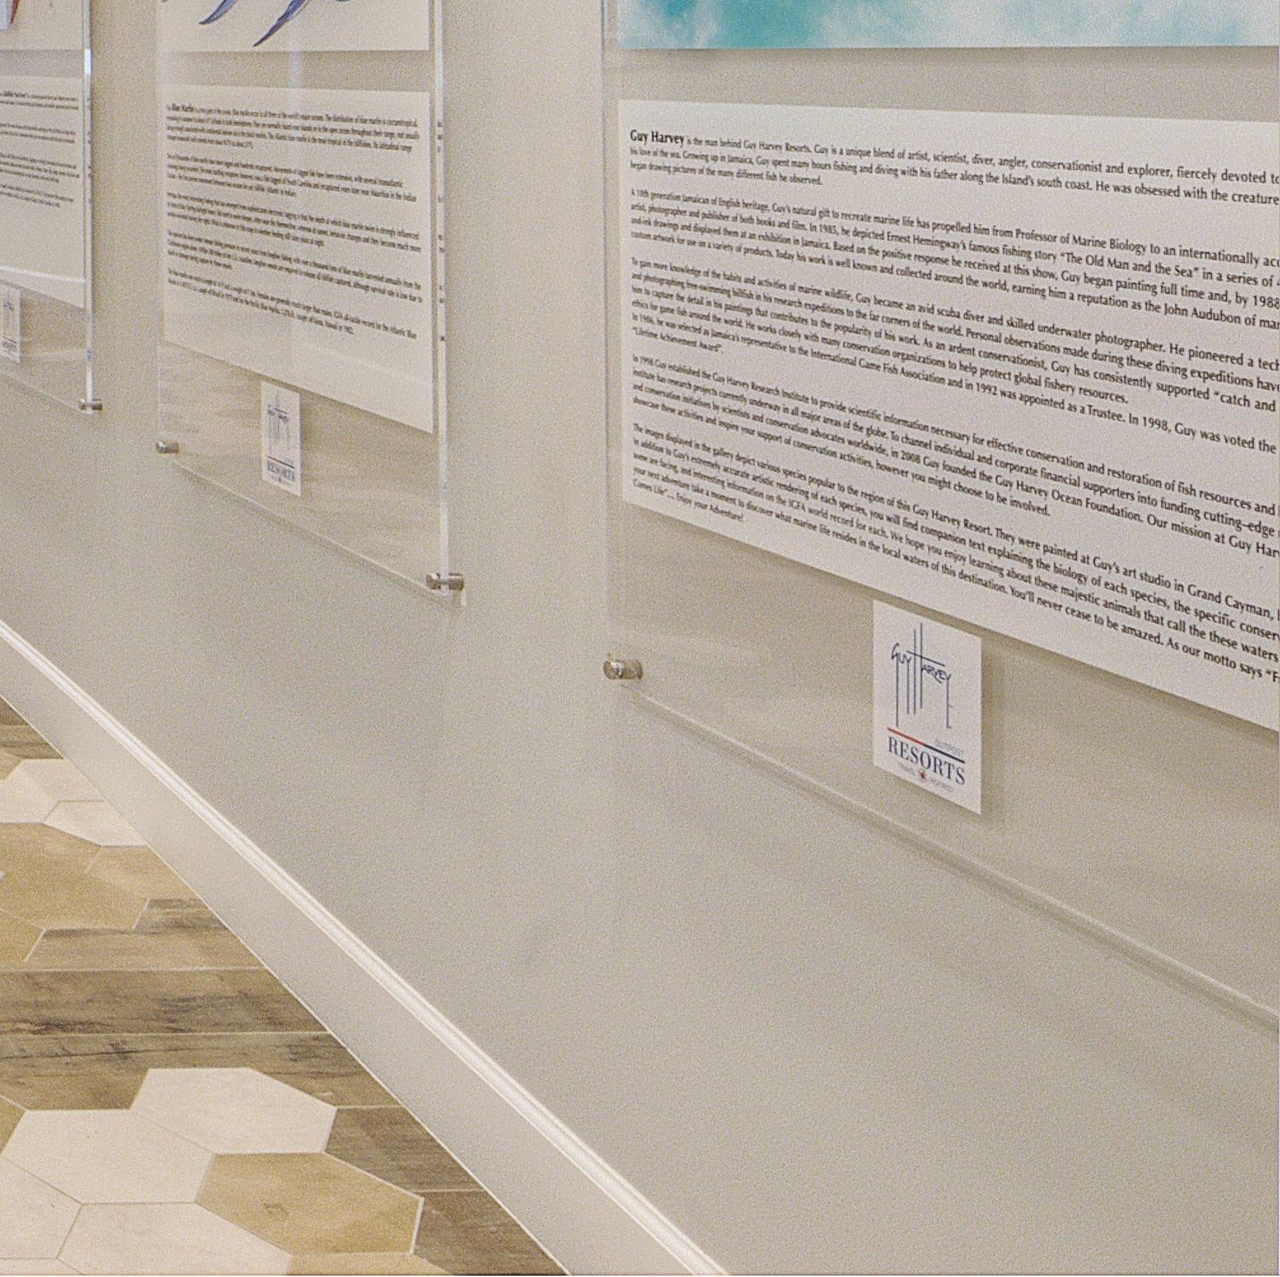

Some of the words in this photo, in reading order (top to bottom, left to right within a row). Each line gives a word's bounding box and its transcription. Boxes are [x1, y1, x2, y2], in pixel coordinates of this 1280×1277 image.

[629, 129, 648, 146] Guy
[651, 130, 684, 148] Harvey
[845, 146, 871, 159] unique
[873, 146, 895, 159] blend
[897, 148, 905, 159] of
[907, 150, 930, 162] artist,
[933, 151, 969, 165] scientist,
[971, 153, 995, 167] diver,
[998, 155, 1028, 170] angler,
[1031, 159, 1102, 173] conservationist
[1105, 162, 1124, 174] and
[1127, 163, 1173, 179] explorer,
[1176, 165, 1217, 183] fiercely
[1220, 168, 1266, 184] devoted
[1036, 176, 1062, 188] south
[1064, 180, 1092, 191] coast.
[1096, 180, 1110, 192] He
[1112, 184, 1132, 194] was
[1134, 182, 1180, 197] obsessed
[1183, 186, 1207, 199] with
[1210, 188, 1228, 201] the
[1034, 250, 1057, 264] story
[1085, 254, 1104, 267] Old
[1107, 257, 1129, 270] Man
[1132, 260, 1151, 273] and
[1154, 262, 1171, 275] the
[1202, 267, 1213, 280] in
[1216, 272, 1222, 282] a
[1226, 271, 1258, 285] series
[1261, 274, 1274, 287] of
[1060, 232, 1070, 244] of
[1072, 234, 1106, 249] Marine
[1109, 238, 1147, 256] Biology
[1149, 243, 1160, 254] to
[1163, 246, 1176, 256] an
[1179, 244, 1259, 269] internationally
[1032, 266, 1058, 281] show,
[1060, 269, 1080, 286] Guy
[1083, 271, 1113, 289] began
[1115, 277, 1158, 297] painting
[1160, 281, 1177, 295] full
[1180, 284, 1205, 299] time
[1207, 289, 1232, 305] and,
[1235, 291, 1248, 308] by
[1048, 285, 1066, 299] him
[1069, 292, 1075, 301] a
[1077, 293, 1128, 308] reputation
[1131, 301, 1142, 310] as
[1144, 299, 1161, 313] the
[1163, 302, 1188, 317] John
[1191, 306, 1241, 324] Audubon
[1244, 313, 1256, 326] of
[1037, 323, 1091, 340] underwater
[1094, 330, 1166, 353] photographer.
[1169, 342, 1185, 356] He
[1188, 345, 1244, 366] pioneered
[1247, 358, 1254, 367] a
[1062, 346, 1089, 359] made
[1091, 348, 1124, 368] during
[1126, 354, 1153, 370] these
[1155, 359, 1188, 380] diving
[1190, 368, 1253, 388] expeditions
[1044, 376, 1075, 396] fishery
[1078, 386, 1128, 404] resources.
[1050, 360, 1070, 377] Guy
[1073, 363, 1090, 378] has
[1093, 371, 1152, 392] consistently
[1155, 382, 1210, 400] supported
[1254, 399, 1276, 412] and
[1067, 402, 1077, 413] as
[1079, 405, 1085, 414] a
[1087, 404, 1125, 422] Trustee.
[1128, 412, 1139, 425] In
[1142, 416, 1171, 434] 1998,
[1174, 422, 1196, 440] Guy
[1199, 430, 1220, 442] was
[1223, 434, 1255, 449] voted
[1258, 439, 1276, 454] the
[1083, 481, 1135, 501] supporters
[1137, 490, 1158, 507] into
[1160, 496, 1201, 521] funding
[1087, 463, 1105, 475] and
[1107, 468, 1162, 488] restoration
[1164, 479, 1175, 492] of
[1177, 481, 1196, 497] fish
[1199, 490, 1251, 510] resources
[1254, 503, 1275, 516] and
[1051, 488, 1083, 507] Ocean
[1085, 497, 1143, 523] Foundation.
[1146, 513, 1168, 529] Our
[1170, 521, 1211, 541] mission
[1214, 533, 1225, 544] at
[1228, 534, 1251, 554] Guy
[1053, 561, 1088, 586] biology
[1091, 575, 1101, 587] of
[1103, 581, 1127, 595] each
[1130, 589, 1170, 610] species,
[1173, 599, 1191, 615] the
[1193, 608, 1235, 629] specific
[1080, 554, 1090, 565] at
[1122, 567, 1136, 579] art
[1139, 571, 1171, 588] studio
[1174, 578, 1184, 593] in
[1187, 584, 1222, 604] Grand
[1224, 594, 1274, 621] Cayman,
[1060, 586, 1100, 606] majestic
[1102, 599, 1141, 619] animals
[1143, 609, 1164, 627] that
[1167, 619, 1186, 633] call
[1188, 623, 1206, 639] the
[1209, 630, 1238, 649] these
[1240, 643, 1279, 663] waters
[1064, 606, 1091, 622] cease
[1094, 613, 1104, 626] to
[1106, 615, 1119, 631] be
[1121, 624, 1164, 646] amazed.
[1166, 636, 1179, 650] As
[1182, 644, 1200, 657] our
[1203, 651, 1236, 669] motto
[1239, 662, 1262, 679] says
[888, 736, 965, 785] RESORTS
